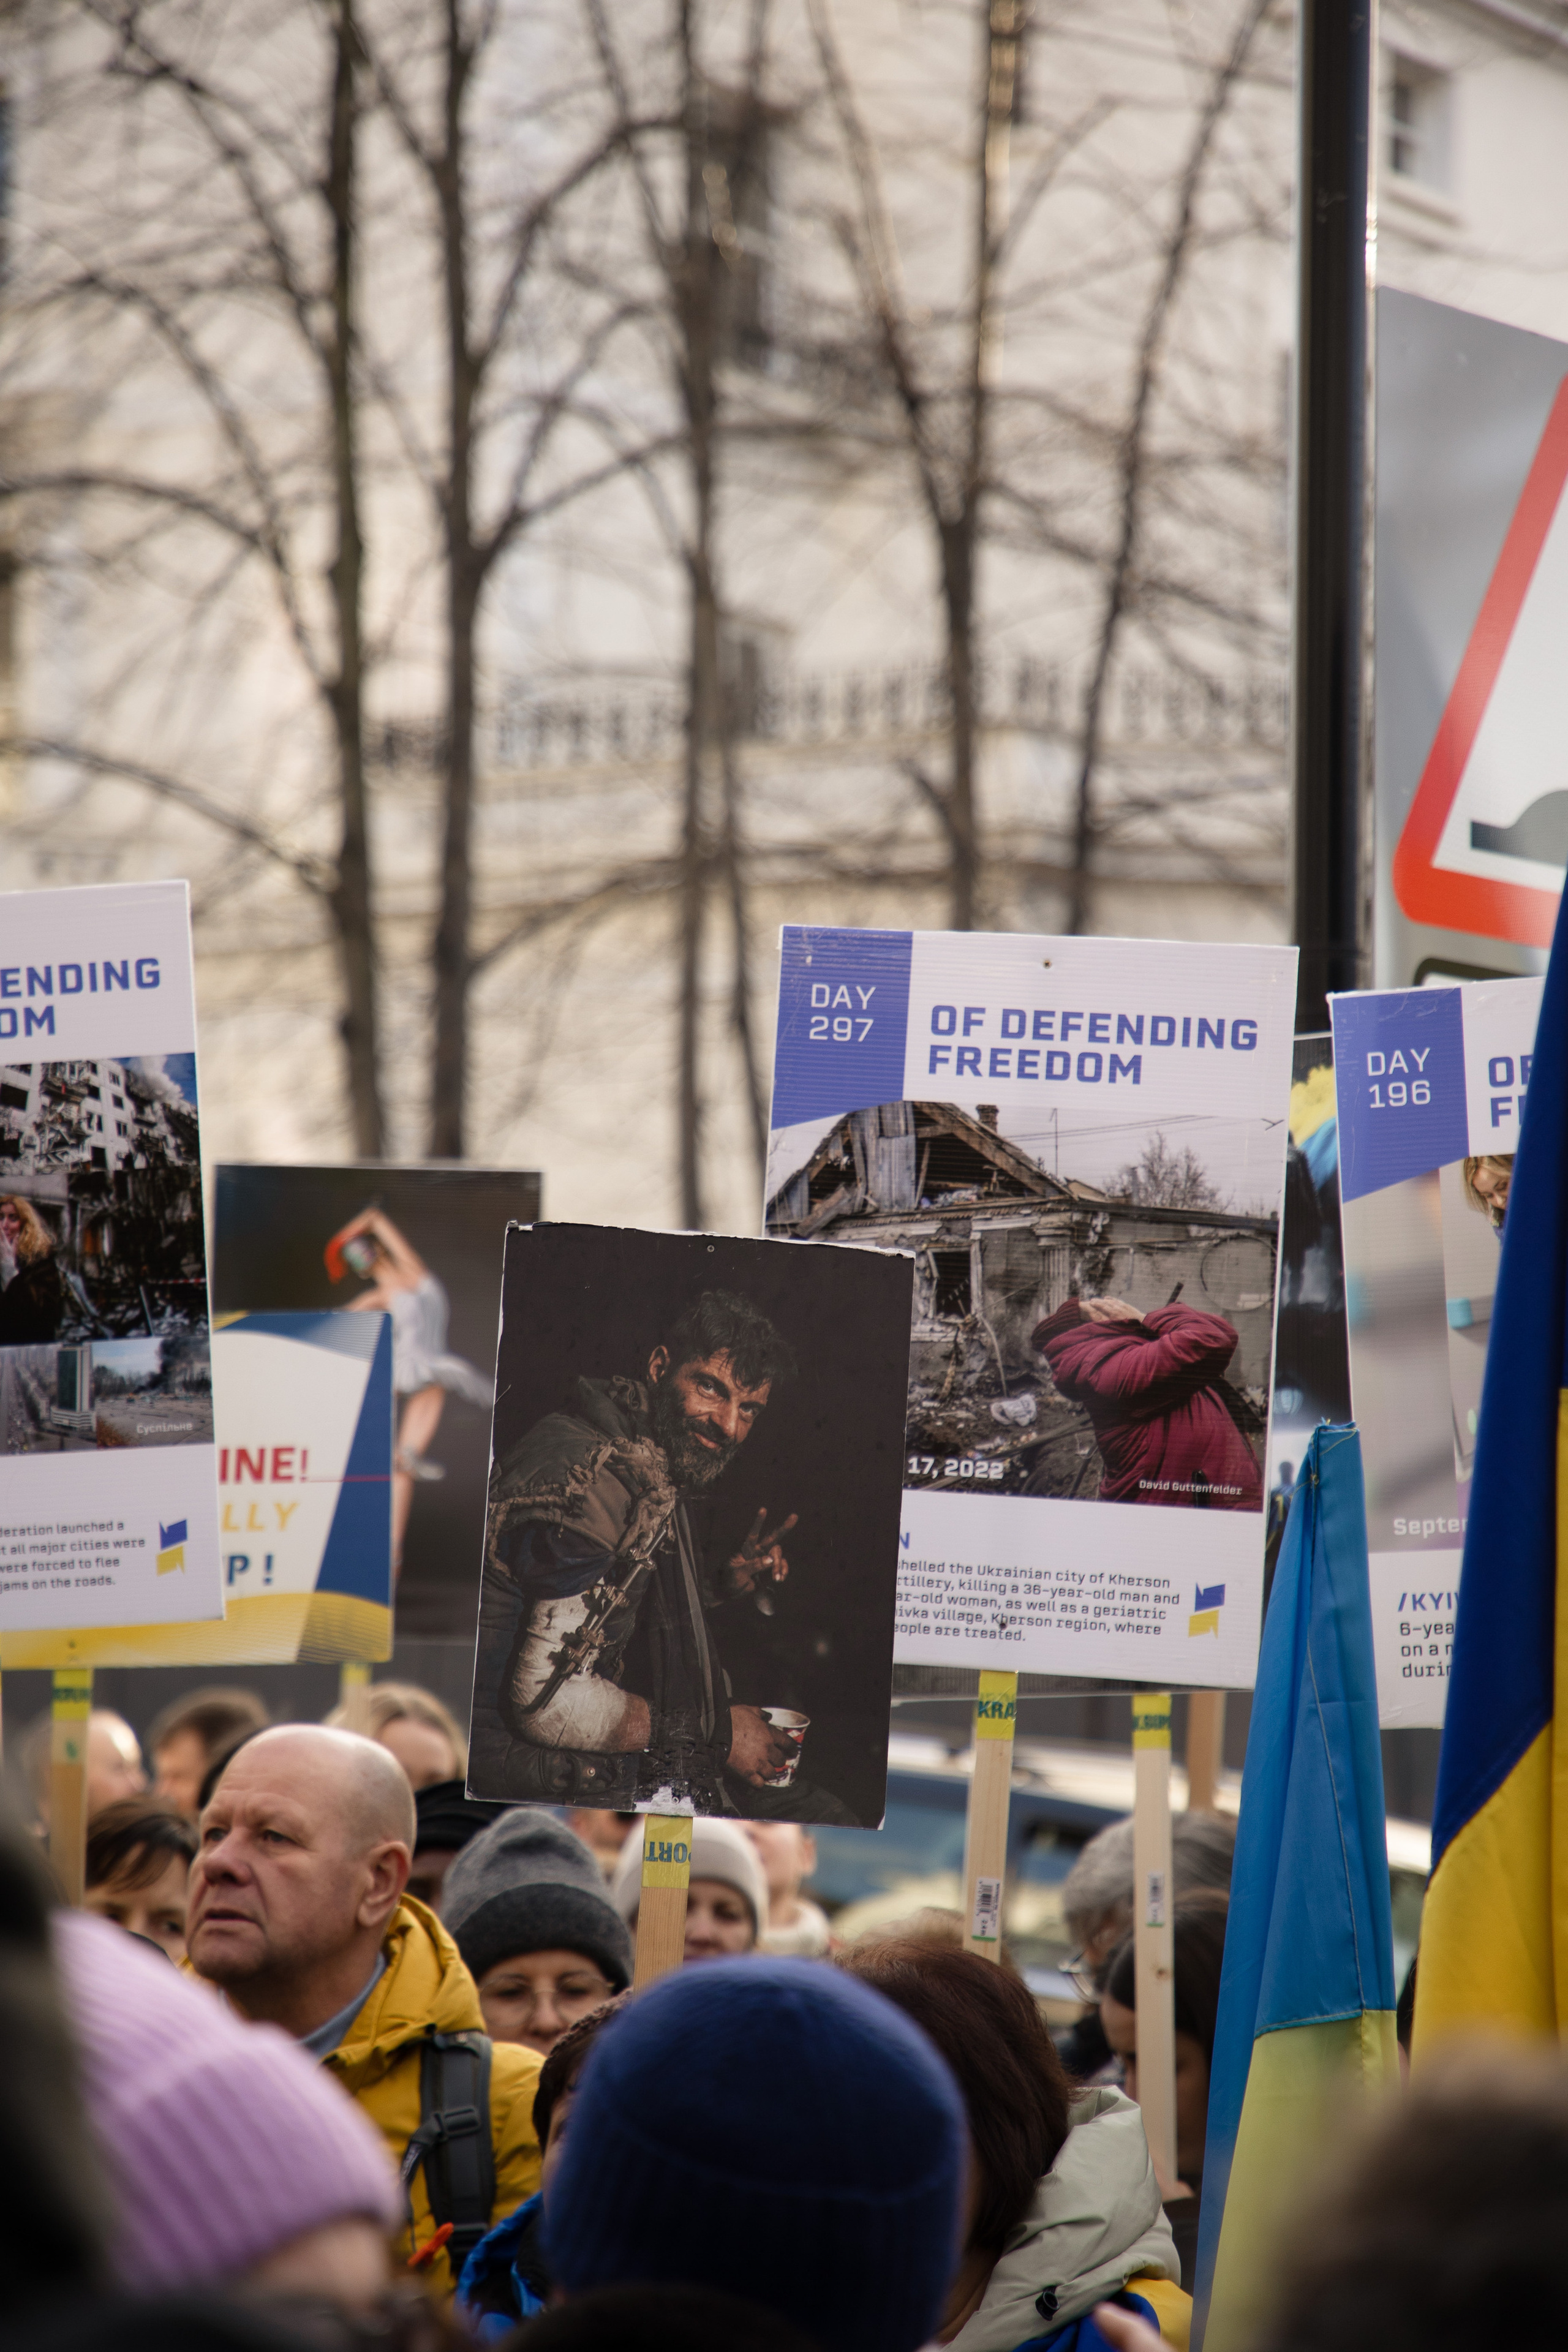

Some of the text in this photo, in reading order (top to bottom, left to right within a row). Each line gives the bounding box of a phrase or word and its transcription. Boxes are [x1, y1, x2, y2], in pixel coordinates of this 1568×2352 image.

[0, 958, 160, 999] ENDING
[810, 983, 876, 1010] DAY
[809, 1016, 874, 1042] 297
[930, 1005, 1258, 1050] OF DEFENDING
[929, 1044, 1142, 1085] FREEDOM
[1366, 1047, 1430, 1076] DAY
[1368, 1080, 1431, 1109] 196
[219, 1446, 308, 1485] INE!
[908, 1455, 1004, 1480] 17, 2022
[1139, 1479, 1243, 1496] David Guttenfelder
[56, 1521, 113, 1534] launched
[117, 1522, 124, 1531] a
[222, 1502, 298, 1532] LLY
[10, 1543, 26, 1555] all
[29, 1542, 66, 1556] major
[70, 1540, 110, 1551] cities
[113, 1538, 145, 1550] were
[32, 1559, 75, 1572] forced
[79, 1560, 91, 1569] to
[96, 1558, 120, 1569] flee
[898, 1559, 1170, 1589] helled the Ukrainian city of Kherson
[32, 1580, 47, 1589] on
[51, 1578, 71, 1589] the
[75, 1575, 116, 1588] roads.
[959, 1579, 1006, 1596] killing
[1011, 1585, 1019, 1594] a
[1023, 1583, 1115, 1600] 36-year-old
[1120, 1592, 1149, 1603] man
[1153, 1594, 1180, 1605] and
[947, 1596, 1001, 1610] woman,
[1005, 1600, 1022, 1610] as
[1026, 1600, 1056, 1611] well
[1060, 1604, 1077, 1613] as
[1081, 1605, 1088, 1614] a
[1093, 1605, 1166, 1619] geriatric
[933, 1609, 987, 1625] village,
[991, 1613, 1052, 1627] Kherson
[1056, 1618, 1110, 1634] region,
[1115, 1621, 1161, 1635] where
[935, 1626, 960, 1637] are
[964, 1627, 1026, 1642] treated.
[1401, 1645, 1422, 1657] on
[1429, 1644, 1438, 1656] a
